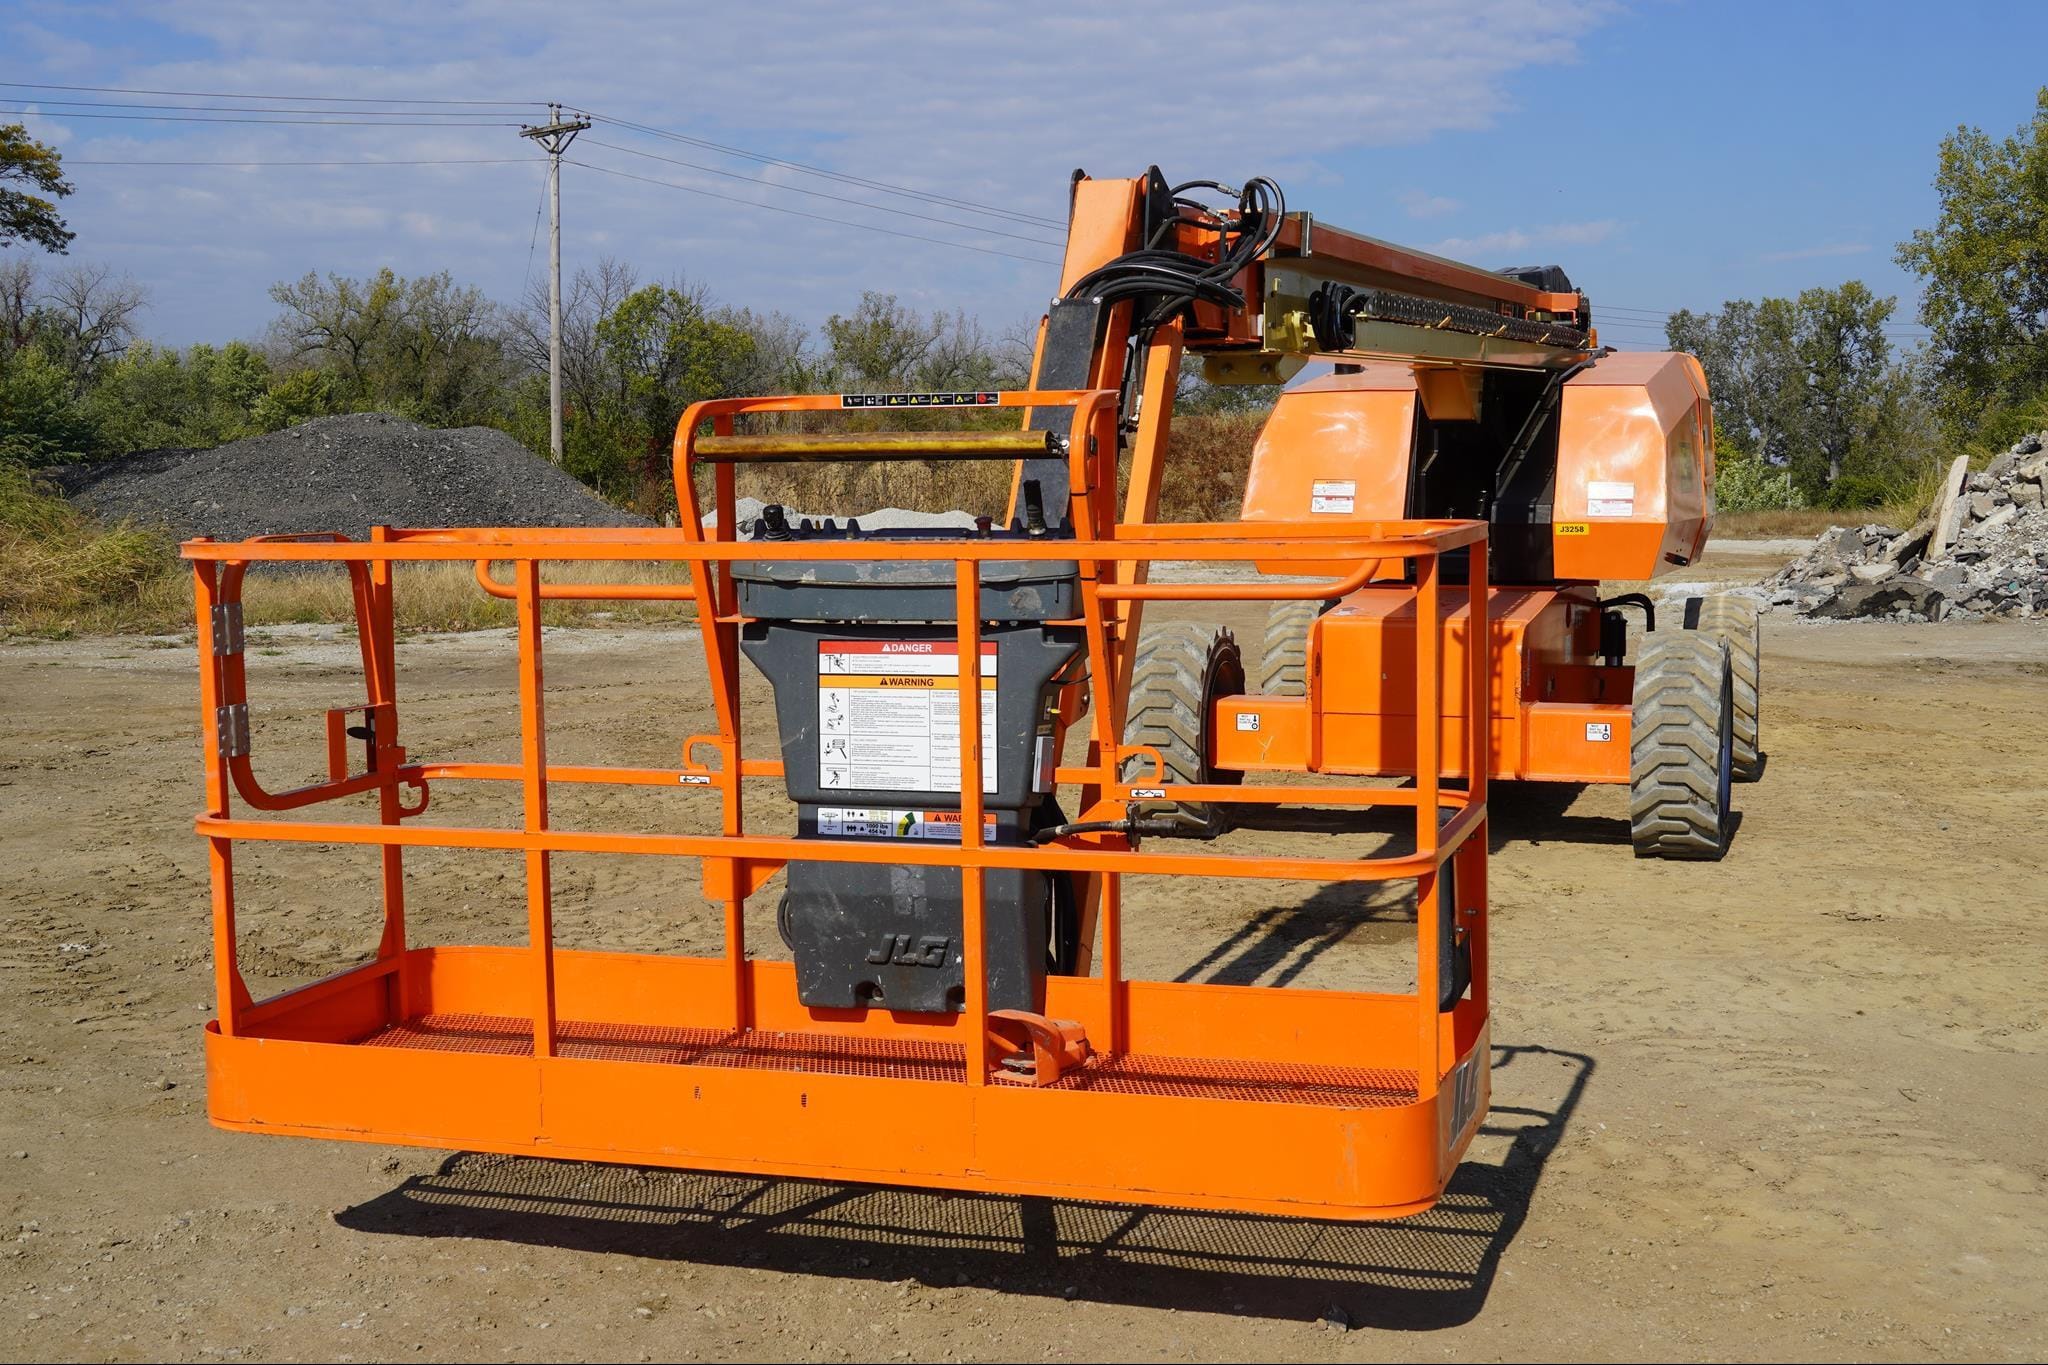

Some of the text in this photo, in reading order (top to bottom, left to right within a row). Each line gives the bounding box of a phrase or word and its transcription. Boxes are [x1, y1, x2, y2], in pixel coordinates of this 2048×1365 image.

[891, 643, 933, 653] DANGER
[888, 677, 935, 687] WARNING
[867, 933, 951, 969] JLG
